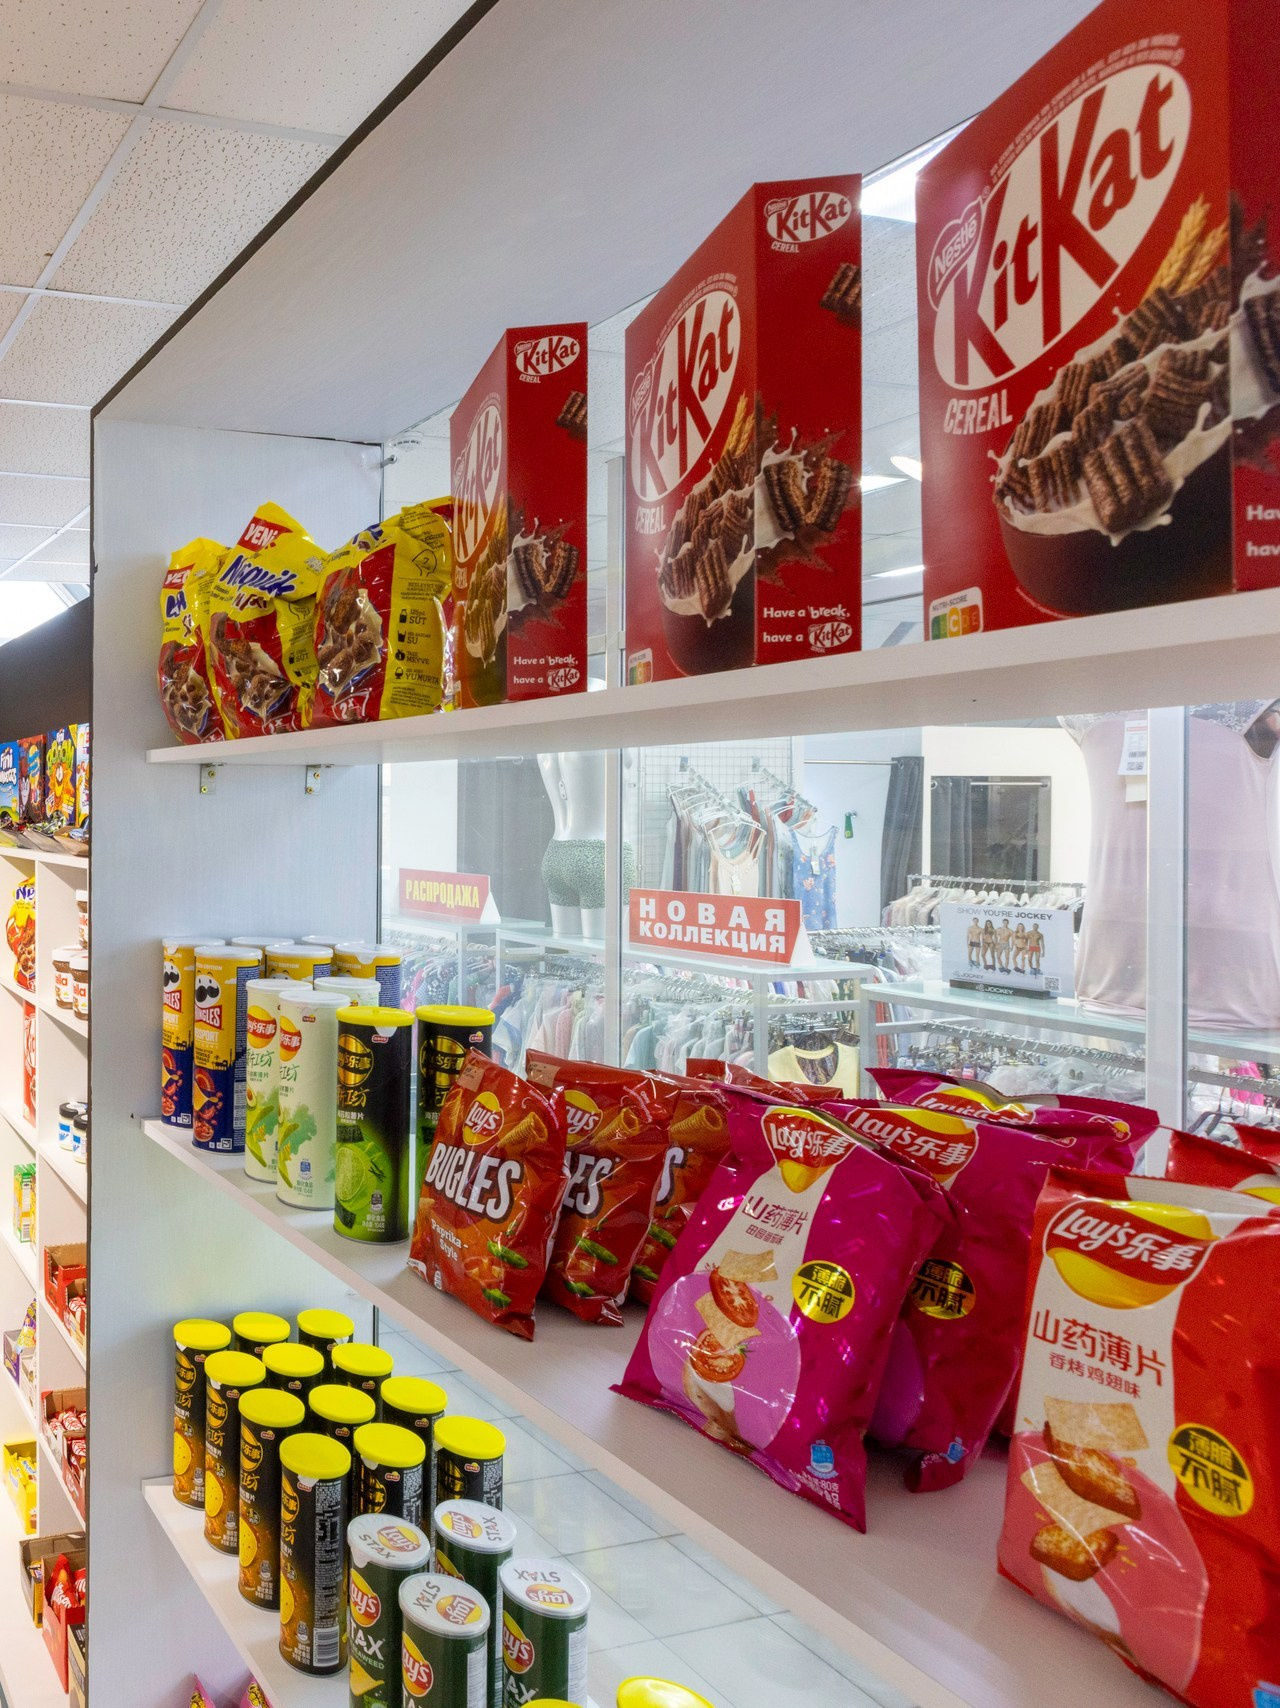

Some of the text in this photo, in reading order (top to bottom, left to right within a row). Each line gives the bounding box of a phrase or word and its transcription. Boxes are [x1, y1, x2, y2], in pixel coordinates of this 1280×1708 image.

[776, 193, 848, 241] KitKat
[953, 72, 1175, 386] KitKat
[771, 241, 799, 253] CEREAL
[934, 211, 978, 283] Nestlé
[523, 337, 577, 374] KitKat
[519, 373, 541, 384] CEREAL
[639, 297, 735, 498] KitKat
[943, 389, 1013, 435] CEREAL
[635, 504, 666, 535] CEREAL
[1246, 505, 1280, 521] Hav
[1246, 543, 1280, 557] hav
[763, 607, 795, 618] Have
[798, 609, 806, 618] a
[763, 624, 850, 647] have a KitKat
[513, 656, 537, 665] Have
[513, 676, 535, 684] have
[549, 669, 579, 686] KitKat
[406, 879, 479, 909] РАСПРОДАЖА
[639, 898, 786, 932] НОВАЯ
[957, 907, 1052, 921] SHOW YOU'RE JOCKEY
[639, 920, 786, 954] КОЛЛЕКЦИЯ
[985, 985, 1013, 995] JOCKEY
[465, 1101, 500, 1133] Lay's
[565, 1107, 599, 1138] ay's
[853, 1109, 912, 1148] Lay's
[908, 1135, 974, 1167] 乐事
[425, 1143, 521, 1219] BUGLES
[742, 1196, 809, 1235] 山药薄片
[1053, 1208, 1131, 1250] Lay's
[431, 1218, 462, 1248] Paprika
[440, 1239, 458, 1261] Style
[1116, 1233, 1203, 1271] 乐事
[1033, 1309, 1166, 1387] 山药薄片
[1049, 1351, 1142, 1399] 香烤鸡翅味
[1187, 1430, 1234, 1471] 薄脆
[1179, 1453, 1243, 1512] 不腻
[482, 1515, 502, 1542] STAX
[358, 1533, 397, 1559] STAX
[513, 1568, 561, 1583] STAX
[351, 1584, 376, 1619] ay's
[412, 1581, 441, 1611] STAX
[351, 1619, 385, 1660] TAX
[503, 1627, 529, 1661] ay's
[403, 1646, 428, 1684] ay's
